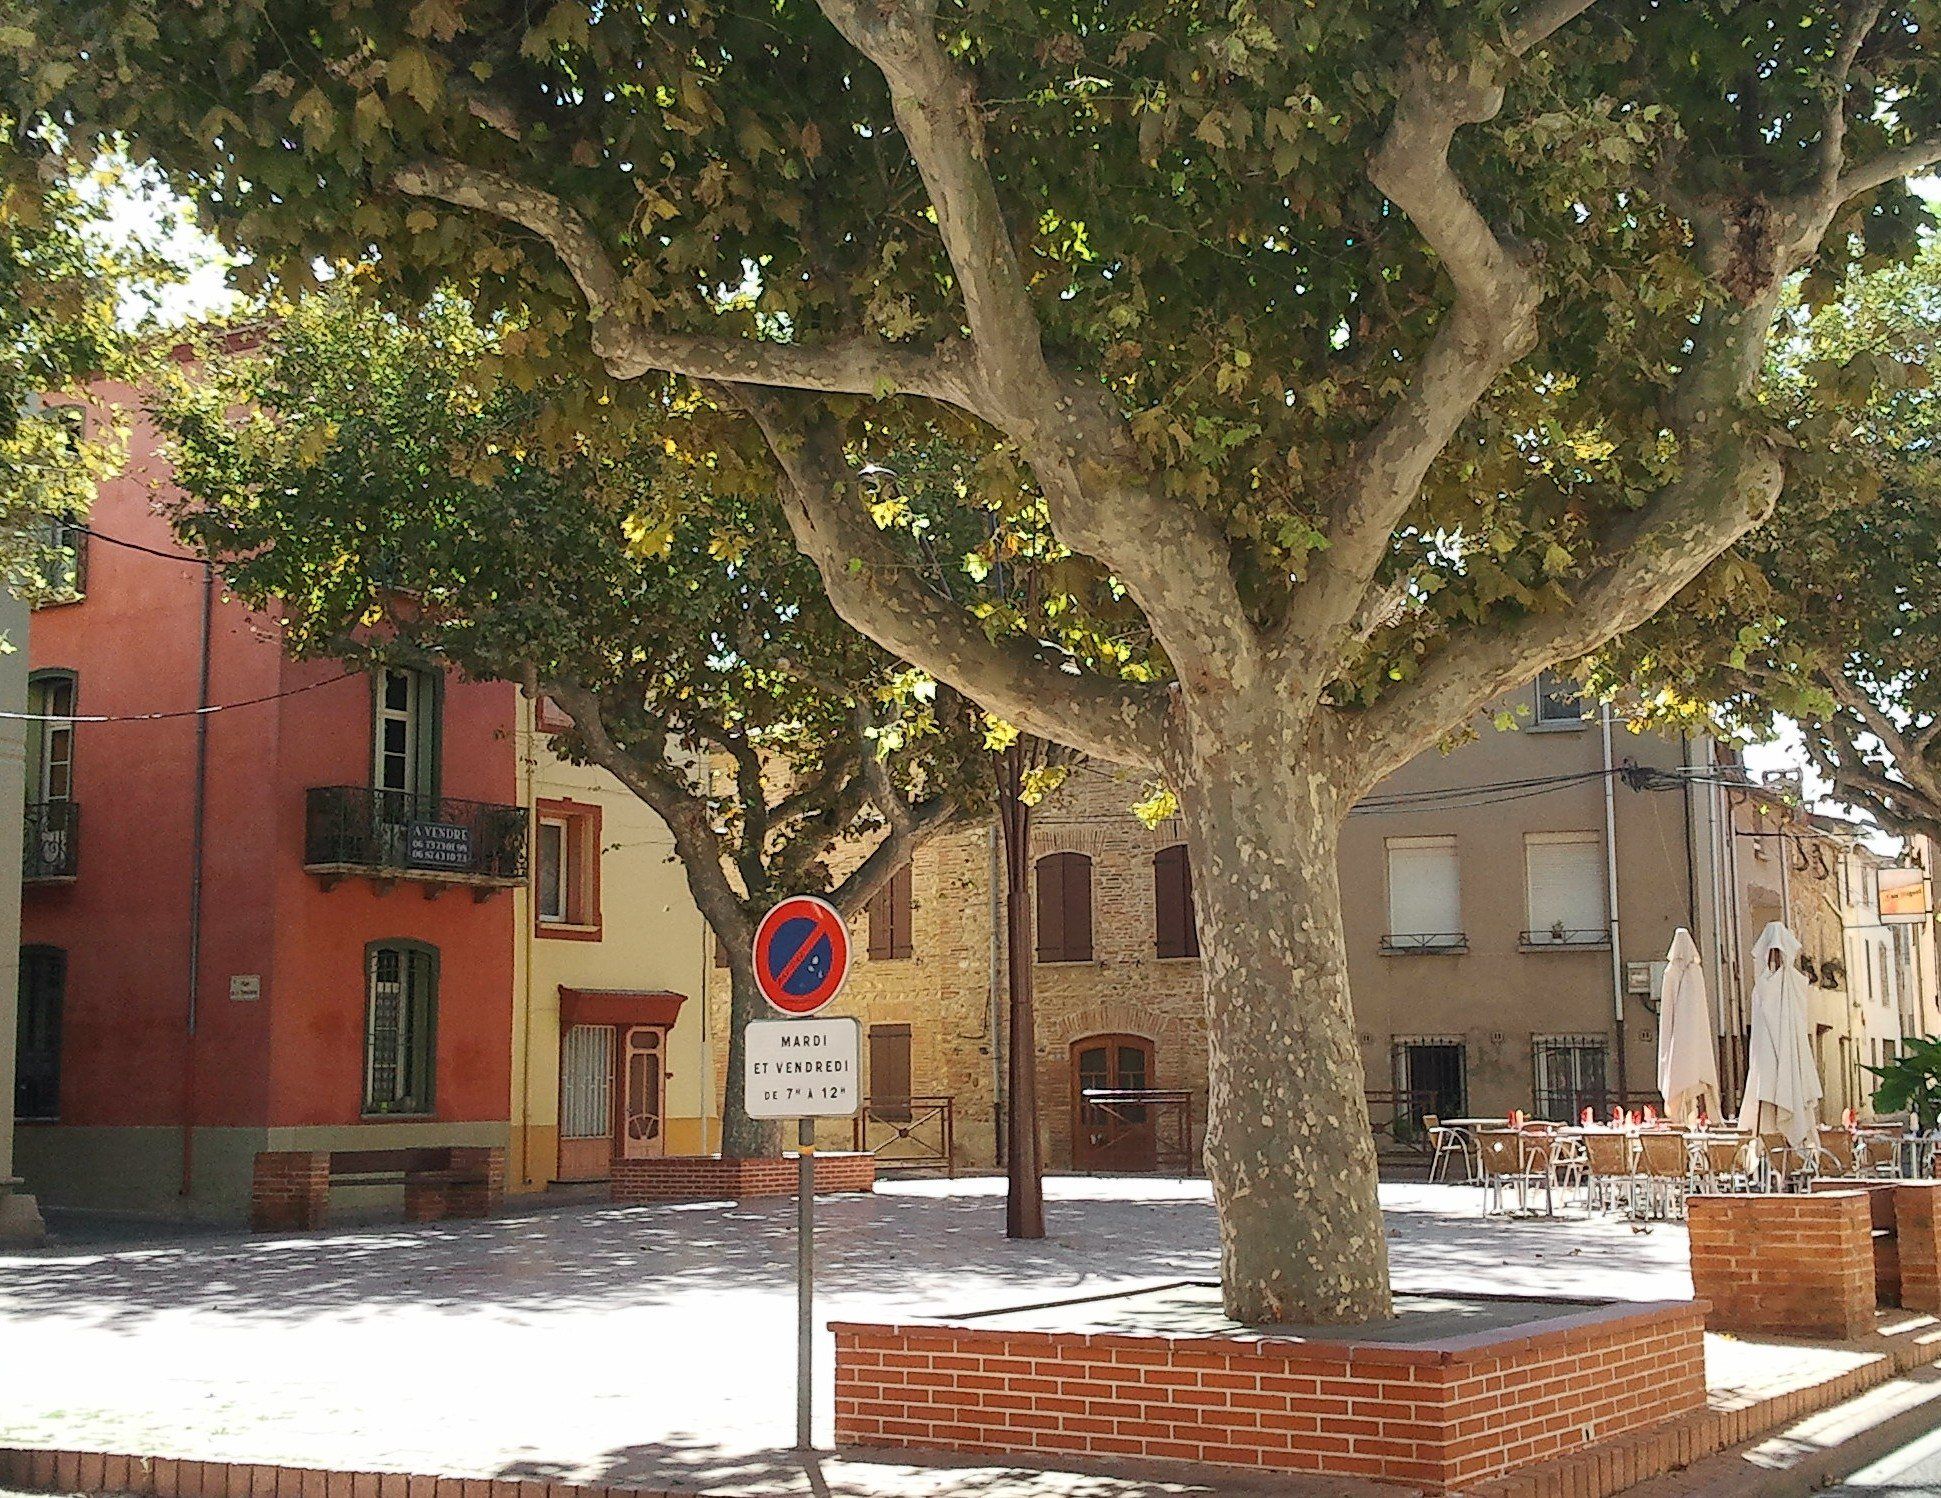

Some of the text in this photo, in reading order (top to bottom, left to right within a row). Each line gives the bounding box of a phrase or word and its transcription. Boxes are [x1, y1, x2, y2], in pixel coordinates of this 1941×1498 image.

[414, 826, 468, 841] A VENDRE
[781, 1034, 827, 1047] MARDI
[754, 1060, 848, 1075] ET VENDREDI
[764, 1090, 778, 1100] DE
